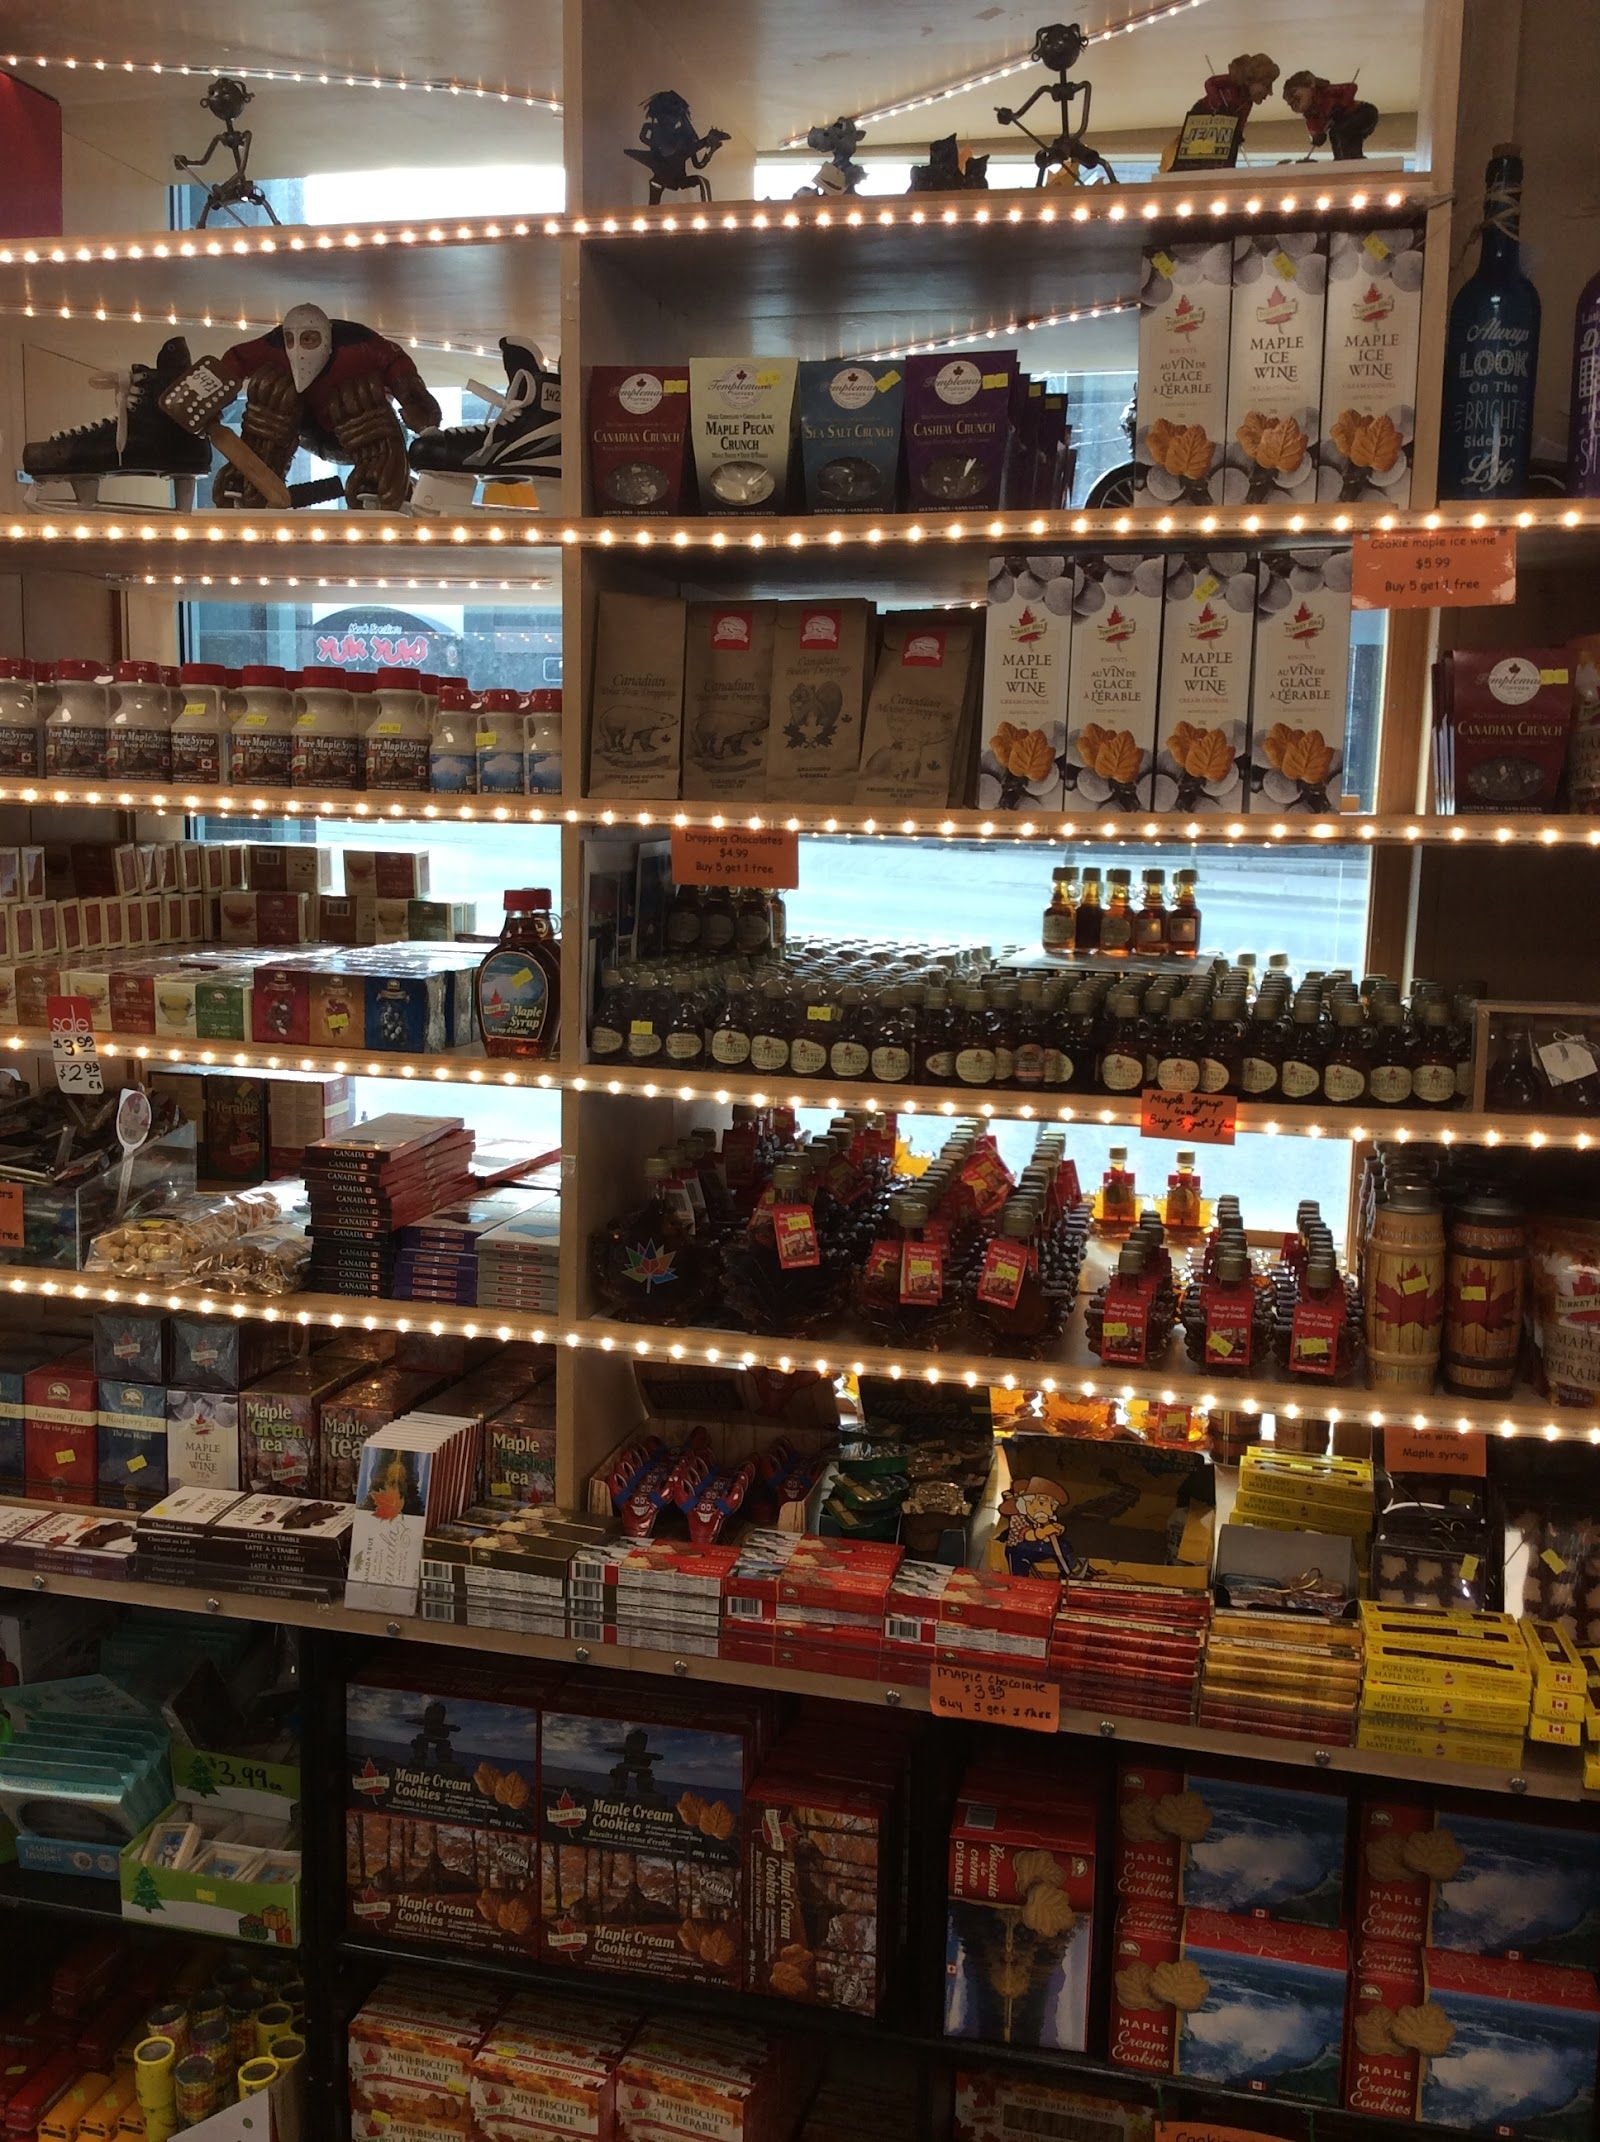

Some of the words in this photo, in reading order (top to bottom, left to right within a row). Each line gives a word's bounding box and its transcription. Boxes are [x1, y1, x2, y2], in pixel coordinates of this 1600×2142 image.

[1467, 317, 1529, 347] Always
[1250, 337, 1304, 351] MAPLE
[1345, 334, 1399, 348] MAPLE
[1264, 351, 1289, 364] ICE
[1358, 349, 1384, 362] ICE
[1349, 363, 1393, 380] WINE
[1459, 350, 1528, 378] LOOK
[1162, 371, 1202, 382] GLACE
[1254, 367, 1298, 382] WINE
[1469, 381, 1488, 394] On
[1494, 381, 1518, 393] The
[1464, 399, 1520, 431] BRIGHT
[594, 429, 640, 443] CANADIAN
[642, 429, 681, 443] CRUNCH
[706, 421, 739, 435] MAPLE
[742, 421, 774, 435] PECAN
[804, 427, 824, 439] SEA
[827, 424, 852, 438] SALT
[855, 424, 894, 437] CRUNCH
[913, 422, 953, 437] CASHEW
[956, 421, 996, 435] CRUNCH
[720, 437, 759, 450] CRUNCH
[1464, 435, 1491, 448] Side
[1500, 435, 1515, 448] Of
[1371, 538, 1409, 550] Cookie
[1413, 537, 1447, 549] maple
[1450, 538, 1467, 547] ice
[1470, 536, 1496, 546] wine
[1385, 580, 1405, 593] Buy
[1410, 581, 1417, 590] 5
[1421, 582, 1439, 593] get
[1454, 579, 1480, 590] free
[1002, 655, 1052, 666] MAPLE
[1180, 652, 1233, 664] MAPLE
[1014, 669, 1038, 679] ICE
[1193, 666, 1218, 677] ICE
[1006, 682, 1047, 697] WINE
[1093, 679, 1133, 689] GLACE
[1184, 680, 1227, 695] WINE
[1280, 678, 1321, 688] GLACE
[1458, 721, 1514, 736] CANADIAN
[1517, 721, 1562, 737] CRUNCH
[369, 741, 382, 751] Pure
[384, 741, 407, 751] Maple
[409, 742, 427, 753] Syrup
[686, 832, 727, 845] Dropping
[730, 834, 783, 845] Chocolates
[696, 862, 712, 873] Buy
[716, 862, 722, 871] 5
[726, 865, 740, 874] get
[752, 865, 774, 874] free
[52, 1004, 90, 1032] sale
[514, 1005, 542, 1018] Maple
[509, 1016, 540, 1029] Syrup
[334, 1150, 366, 1159] CANADA
[328, 1161, 361, 1170] CANADA
[327, 1173, 360, 1182] CANADA
[333, 1185, 363, 1194] CANADA
[336, 1195, 368, 1205] CANADA
[339, 1218, 369, 1227] CANADA
[333, 1230, 364, 1239] CANADA
[339, 1248, 370, 1257] CANADA
[338, 1259, 369, 1268] CANADA
[339, 1271, 369, 1280] CANADA
[338, 1282, 369, 1291] CANADA
[246, 1402, 292, 1420] Maple
[251, 1419, 305, 1439] Green
[324, 1417, 368, 1438] Maple
[185, 1442, 221, 1453] MAPLE
[260, 1438, 283, 1453] tea
[492, 1433, 540, 1454] Maple
[194, 1452, 211, 1462] ICE
[1402, 1447, 1436, 1459] Maple
[1439, 1449, 1469, 1462] syrup
[188, 1461, 218, 1473] WINE
[505, 1469, 529, 1486] tea
[1374, 1671, 1401, 1680] MAPLE
[1403, 1673, 1432, 1683] SUGAR
[939, 1696, 962, 1712] Buy
[974, 1702, 981, 1711] 5
[987, 1705, 1005, 1715] get
[1373, 1701, 1400, 1710] MAPLE
[1401, 1703, 1430, 1713] SUGAR
[208, 1757, 268, 1788] $3.99
[395, 1768, 431, 1785] Maple
[433, 1776, 471, 1792] Cream
[395, 1784, 441, 1801] Cookies
[592, 1799, 630, 1816] Maple
[633, 1807, 674, 1822] Cream
[592, 1814, 641, 1832] Cookies
[1124, 1850, 1174, 1866] MAPLE
[780, 1858, 795, 1898] Maple
[988, 1843, 1006, 1899] Biscuits
[1124, 1862, 1172, 1884] Cream
[766, 1856, 779, 1906] Cookies
[1117, 1877, 1175, 1900] Cookies
[1370, 1889, 1423, 1906] MAPLE
[397, 1895, 434, 1912] Maple
[435, 1902, 475, 1918] Cream
[1127, 1906, 1176, 1922] Cream
[1368, 1903, 1422, 1925] Cream
[398, 1909, 443, 1926] Cookies
[780, 1900, 795, 1940] Cream
[1120, 1916, 1179, 1933] Cookies
[594, 1926, 632, 1943] Maple
[634, 1933, 675, 1949] Cream
[1362, 1918, 1423, 1944] Cookies
[595, 1942, 643, 1958] Cookies
[1363, 1949, 1413, 1965] Cream
[1357, 1959, 1419, 1976] Cookies
[1120, 2017, 1169, 2035] MAPLE
[1118, 2030, 1169, 2054] Cream
[387, 2052, 462, 2075] MINI-BISCUITS
[1112, 2045, 1169, 2069] Cookies
[1358, 2063, 1412, 2081] MAPLE
[1357, 2076, 1410, 2098] Cream
[511, 2094, 586, 2117] MINI-BISCUITS
[656, 2098, 731, 2126] MINI-BISCUITS
[1350, 2092, 1412, 2116] Cookies
[521, 2106, 527, 2115] À
[530, 2108, 575, 2126] L'ÉRABLE
